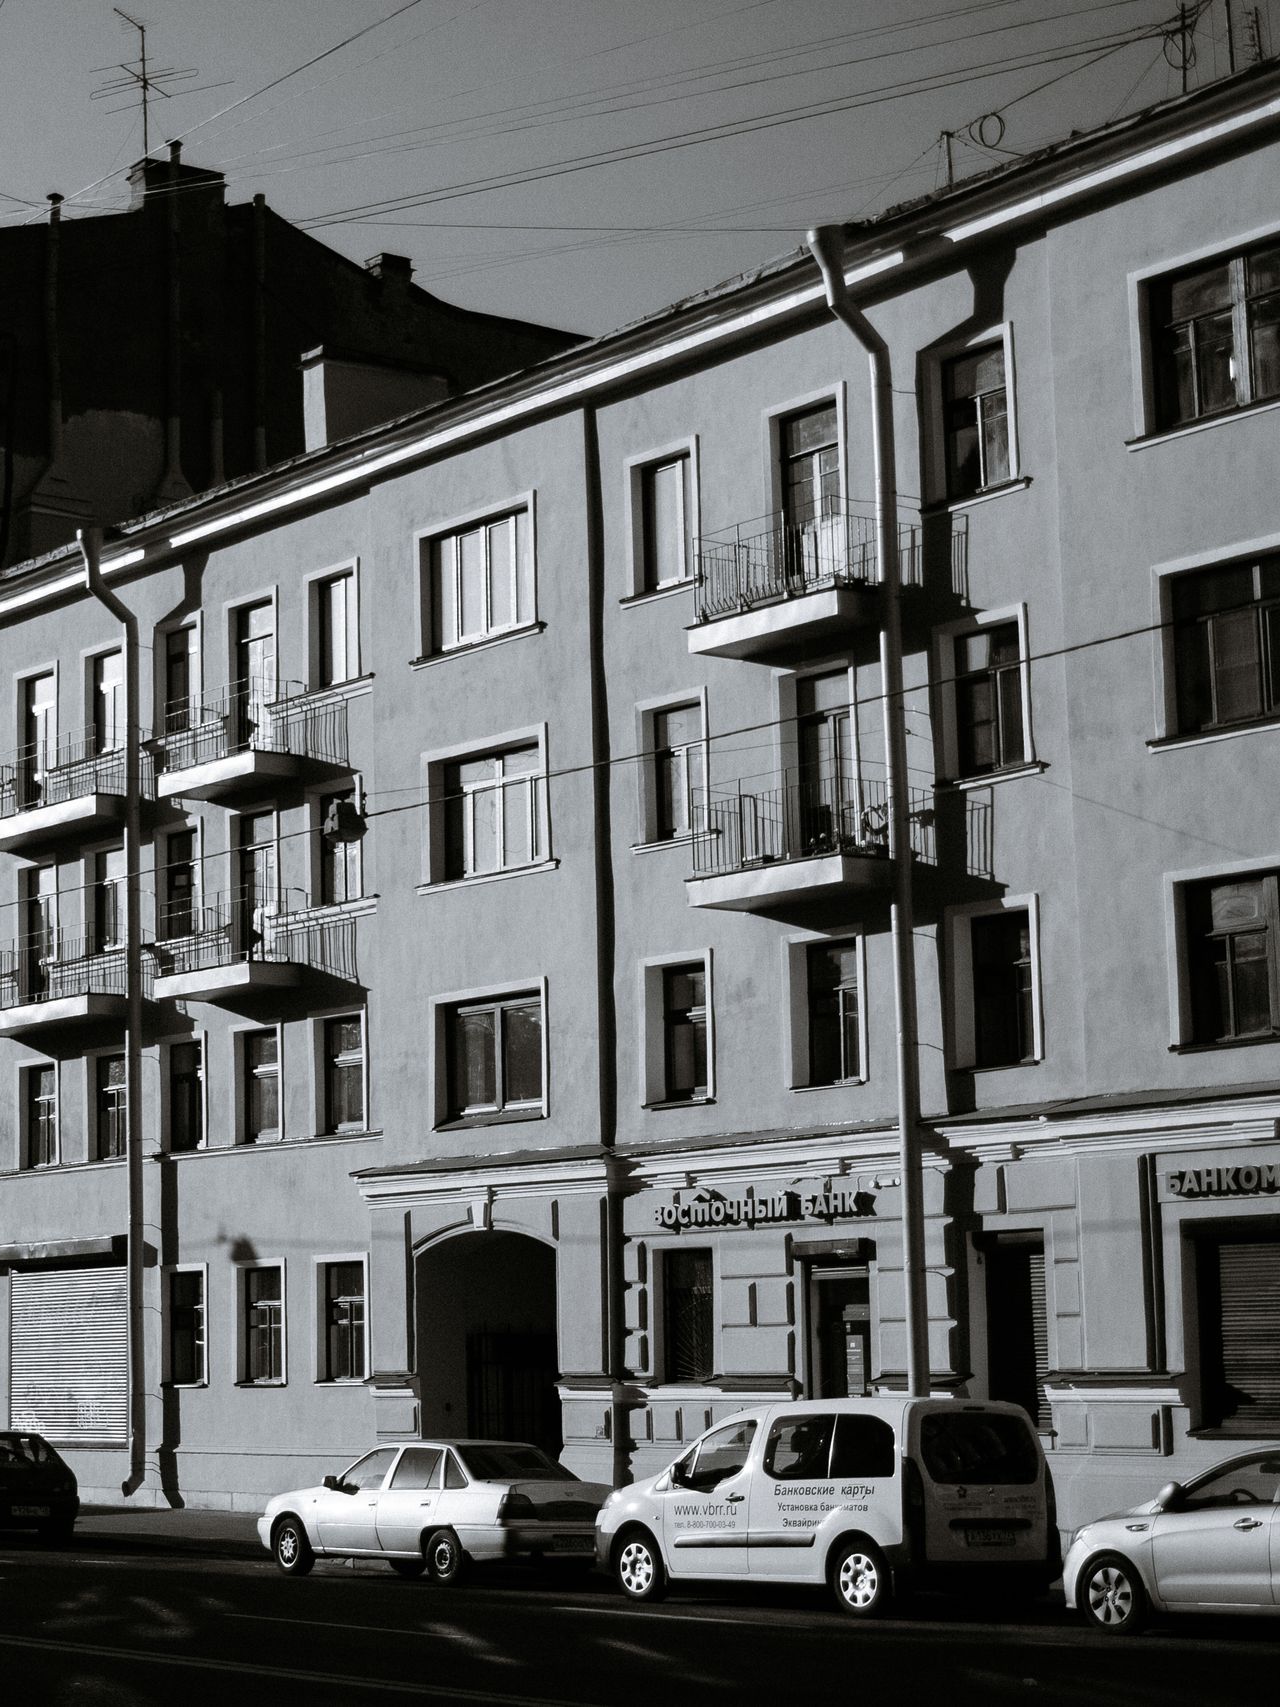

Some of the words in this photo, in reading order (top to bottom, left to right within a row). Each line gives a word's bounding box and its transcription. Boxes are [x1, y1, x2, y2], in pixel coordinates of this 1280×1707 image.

[798, 1191, 858, 1215] БАНК
[774, 1484, 835, 1496] Банковские
[841, 1485, 875, 1498] карты
[673, 1501, 737, 1516] www.vbrr.ru
[777, 1502, 818, 1511] Установка
[782, 1517, 825, 1528] Эквайрин
